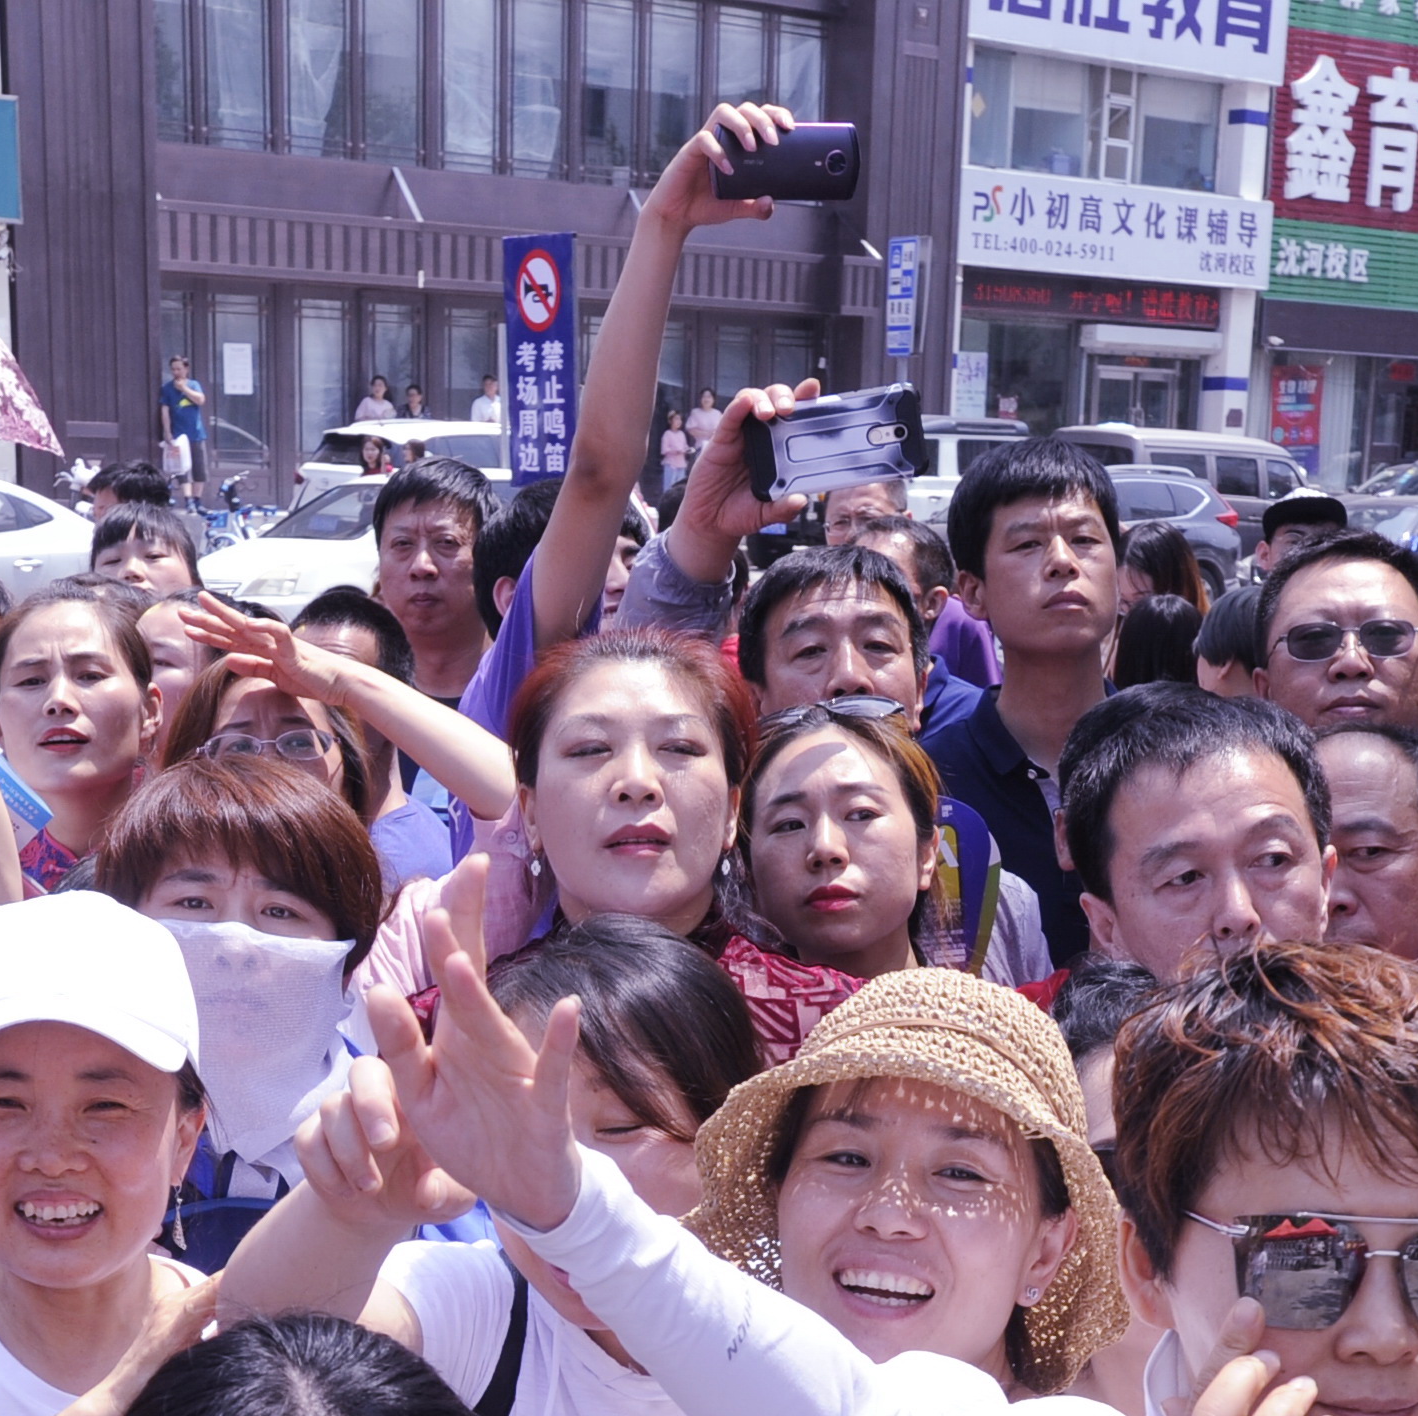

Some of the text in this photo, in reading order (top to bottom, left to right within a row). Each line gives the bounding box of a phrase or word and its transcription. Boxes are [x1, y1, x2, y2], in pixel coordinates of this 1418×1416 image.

[1010, 186, 1259, 249] 小初高文化课辅导
[972, 232, 1116, 262] TEL:400-024-5911
[1199, 250, 1257, 276] 沈河校区
[1276, 238, 1370, 283] 沈河校区
[515, 340, 540, 473] 考场周边
[541, 340, 567, 473] 禁止鸣笛
